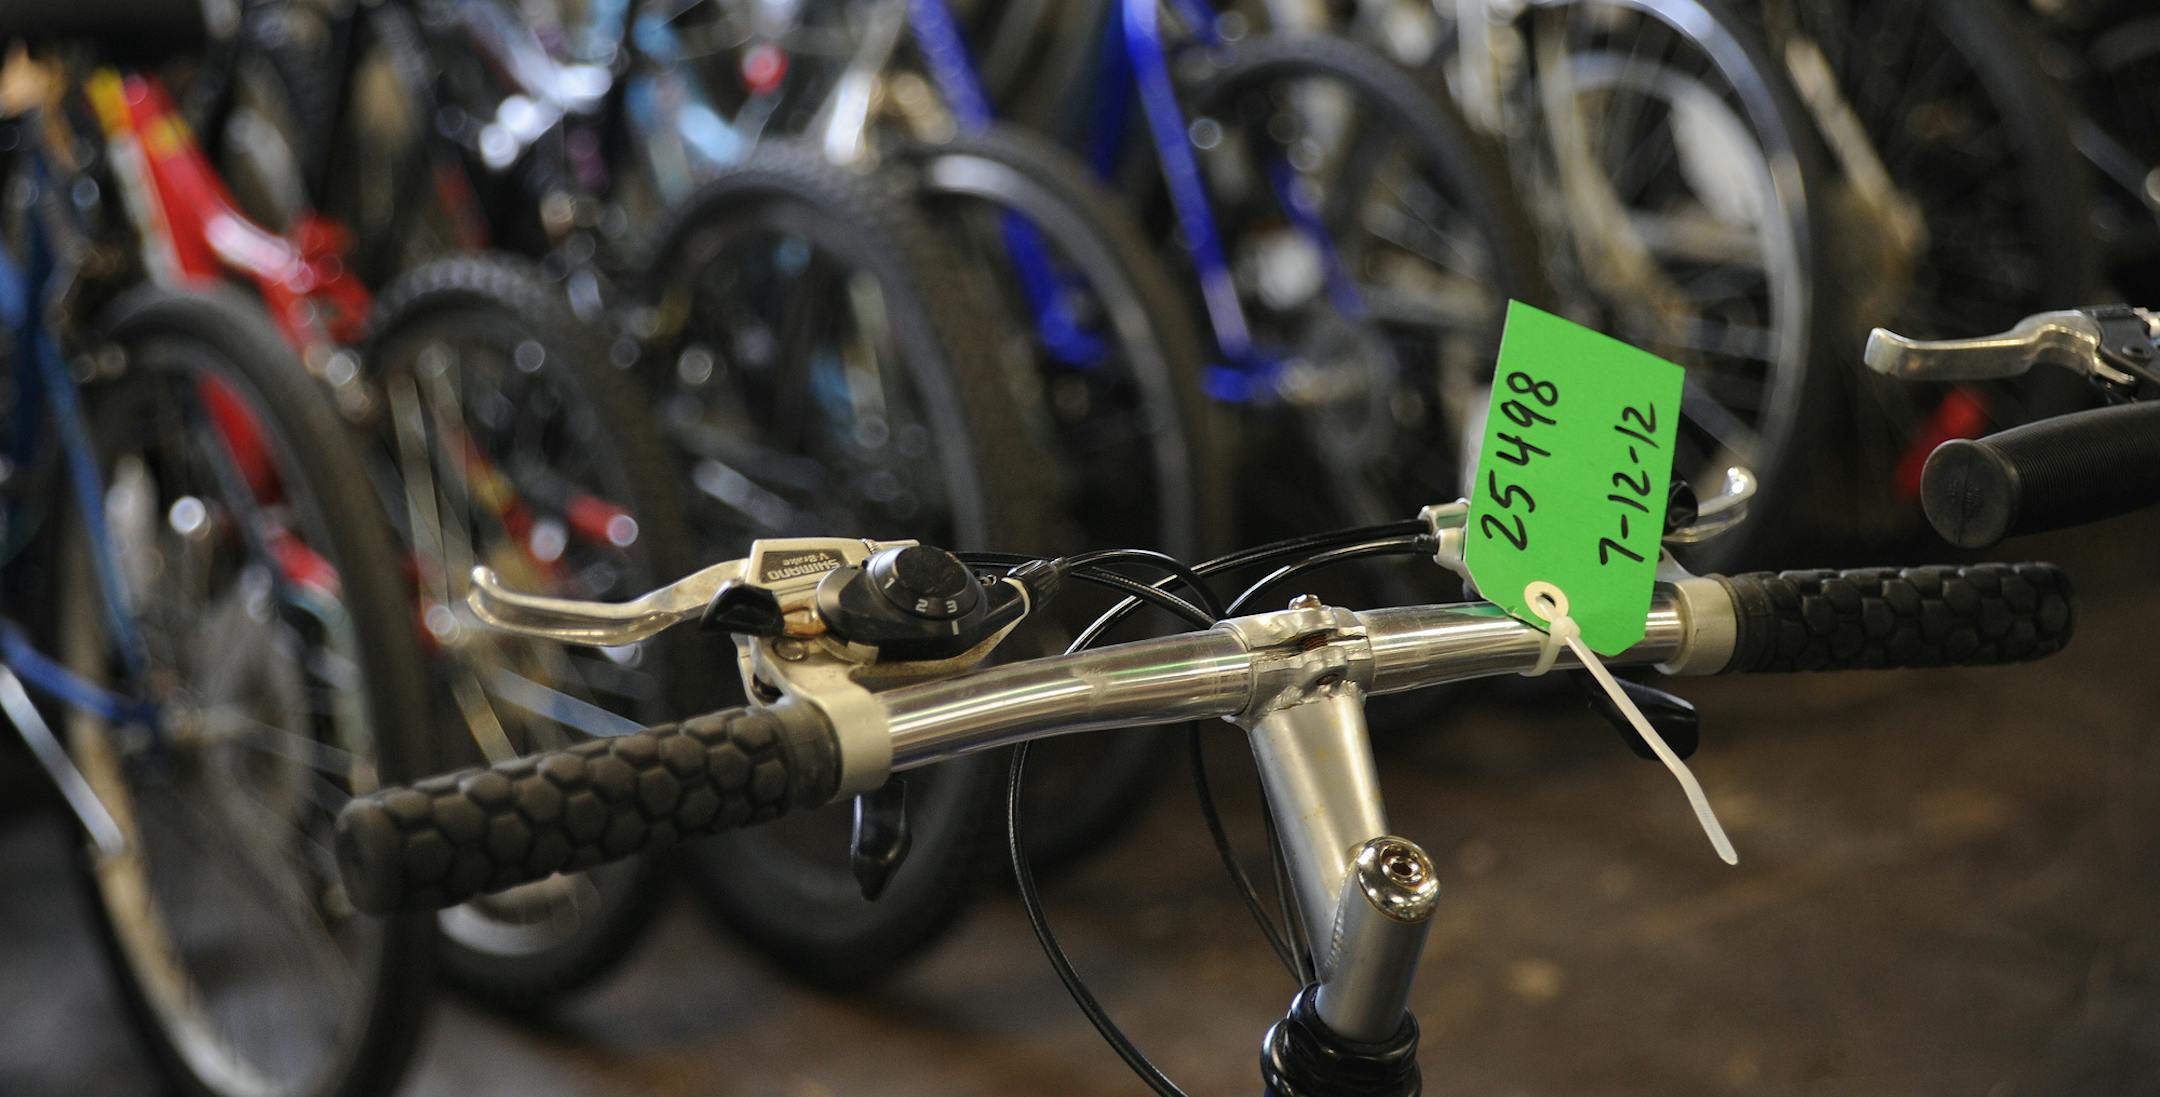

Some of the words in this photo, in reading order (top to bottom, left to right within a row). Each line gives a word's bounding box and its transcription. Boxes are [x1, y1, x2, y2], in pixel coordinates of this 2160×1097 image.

[1481, 371, 1559, 551] 25498
[1599, 403, 1659, 566] 7-12-12
[767, 559, 840, 580] SHIMANO
[884, 577, 895, 589] 1
[915, 599, 929, 613] 2
[945, 600, 958, 613] 3
